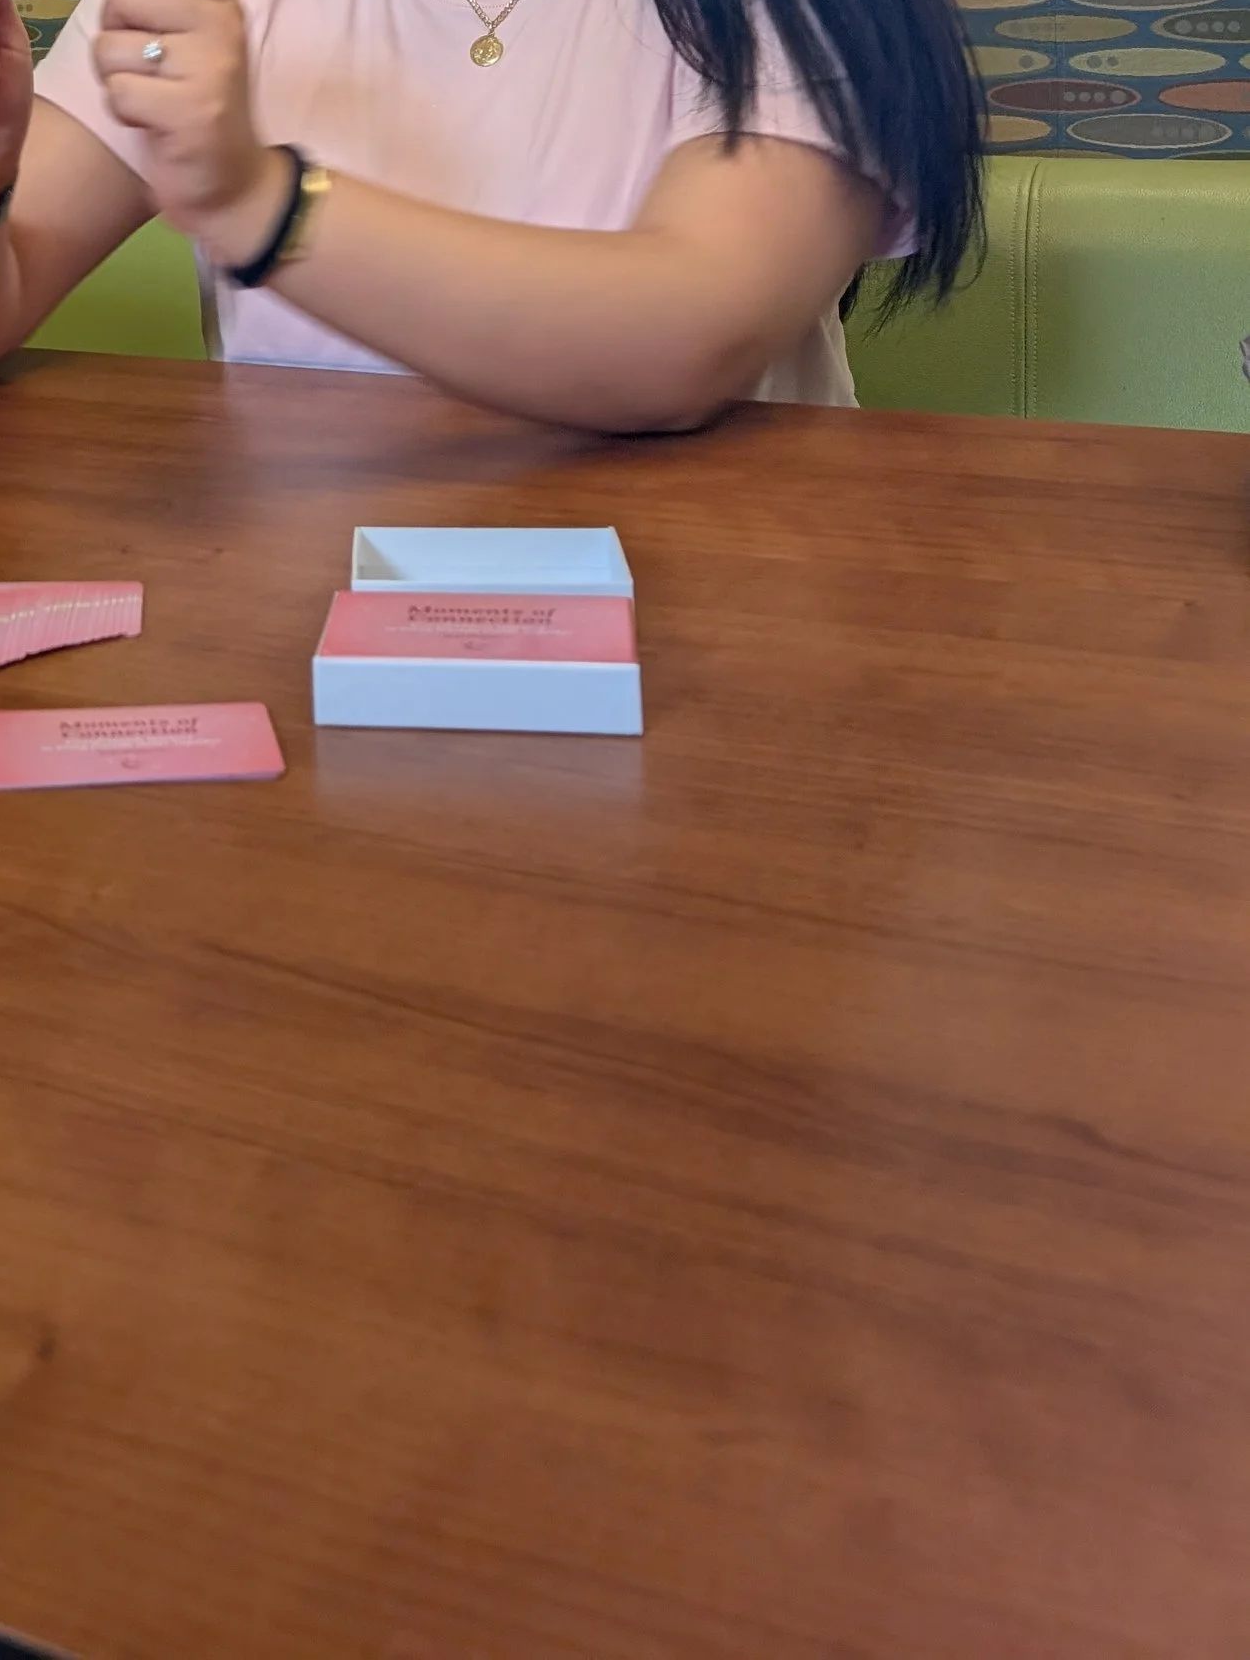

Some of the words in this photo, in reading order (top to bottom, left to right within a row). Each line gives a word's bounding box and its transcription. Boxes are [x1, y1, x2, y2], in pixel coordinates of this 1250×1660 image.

[408, 605, 523, 615] Moments
[532, 608, 557, 617] of
[177, 717, 198, 727] of
